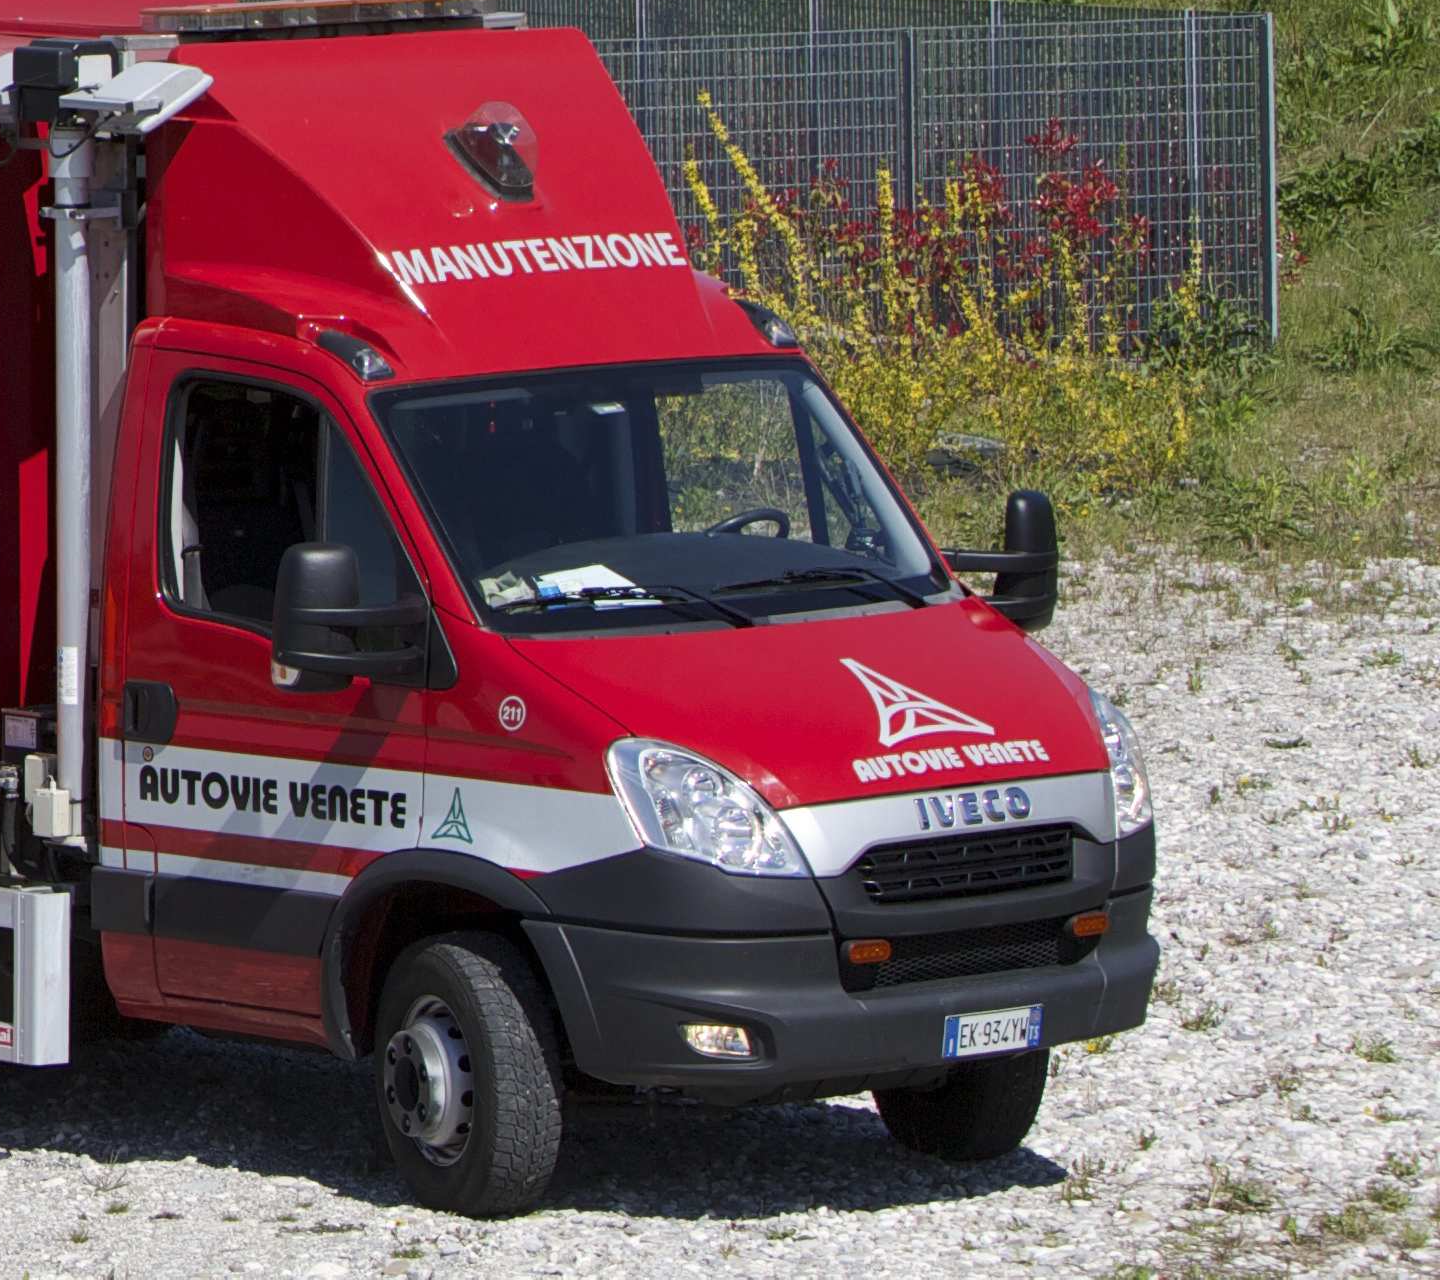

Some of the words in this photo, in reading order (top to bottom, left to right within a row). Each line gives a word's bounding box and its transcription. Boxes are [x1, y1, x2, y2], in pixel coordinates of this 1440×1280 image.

[391, 232, 687, 286] MANUTENZIONE
[502, 705, 522, 721] 211
[852, 747, 965, 783] AUTOVIE
[961, 739, 1050, 767] VENETE
[139, 765, 278, 815] AUTOVIE
[288, 781, 407, 829] VENETE
[912, 786, 1031, 831] IVECO
[960, 1023, 978, 1048] EK
[983, 1016, 1029, 1046] 934YW
